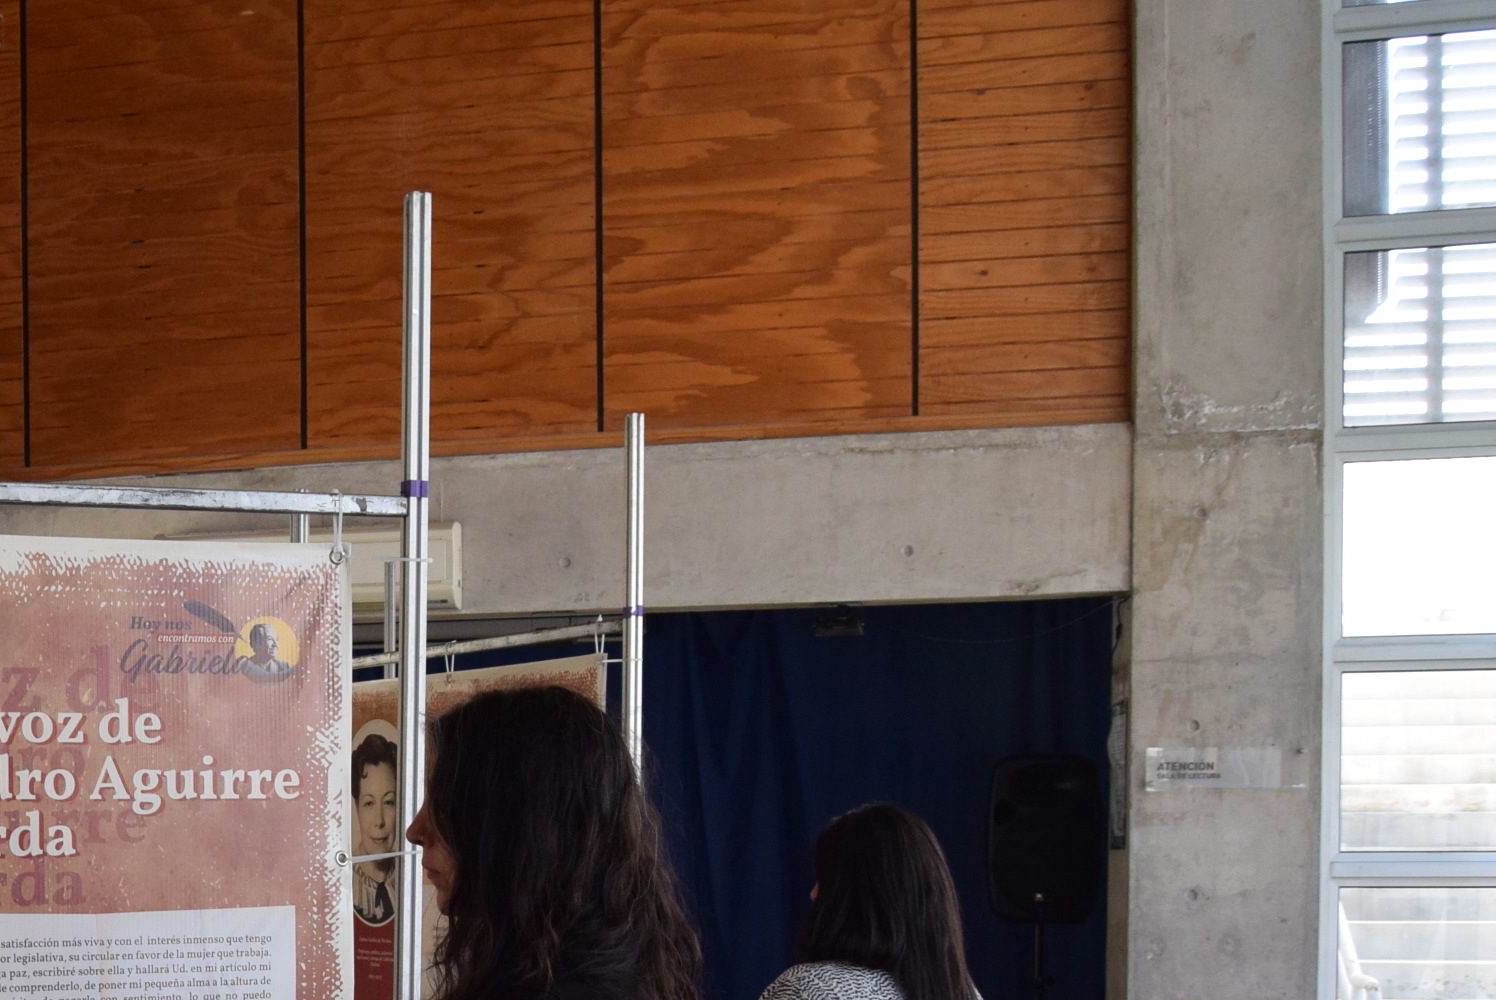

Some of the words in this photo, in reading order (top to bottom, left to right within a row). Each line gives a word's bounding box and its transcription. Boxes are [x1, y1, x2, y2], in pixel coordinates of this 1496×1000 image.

[130, 616, 160, 634] Hoy
[164, 619, 192, 631] nos
[157, 634, 217, 644] encontramos
[217, 634, 234, 643] con
[120, 639, 250, 683] Gabriela
[99, 697, 161, 744] de
[89, 755, 300, 815] Aguirre
[0, 938, 60, 948] satisfacción
[62, 937, 82, 947] más
[84, 937, 105, 946] viva
[106, 939, 113, 948] y
[134, 936, 143, 945] el
[147, 936, 181, 945] interés
[183, 936, 224, 944] inmenso
[226, 936, 244, 945] que
[245, 935, 272, 945] tengo
[13, 953, 67, 965] legislativa,
[81, 951, 120, 961] circular
[136, 950, 161, 959] favor
[162, 950, 174, 959] de
[176, 949, 185, 958] la
[187, 949, 216, 960] mujer
[216, 951, 234, 960] que
[236, 948, 272, 958] trabaja.
[9, 970, 30, 980] paz,
[32, 967, 76, 977] escribiré
[78, 966, 105, 975] sobre
[107, 965, 125, 974] ella
[127, 968, 133, 977] y
[135, 964, 170, 974] hallará
[172, 964, 188, 973] Ud.
[205, 963, 217, 972] mi
[220, 962, 257, 973] artículo
[259, 962, 272, 971] mi
[8, 981, 82, 994] comprenderlo,
[84, 980, 96, 990] de
[98, 982, 128, 992] poner
[129, 979, 142, 988] mi
[144, 979, 185, 991] pequeña
[187, 978, 211, 987] alma
[220, 977, 229, 986] la
[230, 977, 258, 986] altura
[260, 976, 271, 984] de
